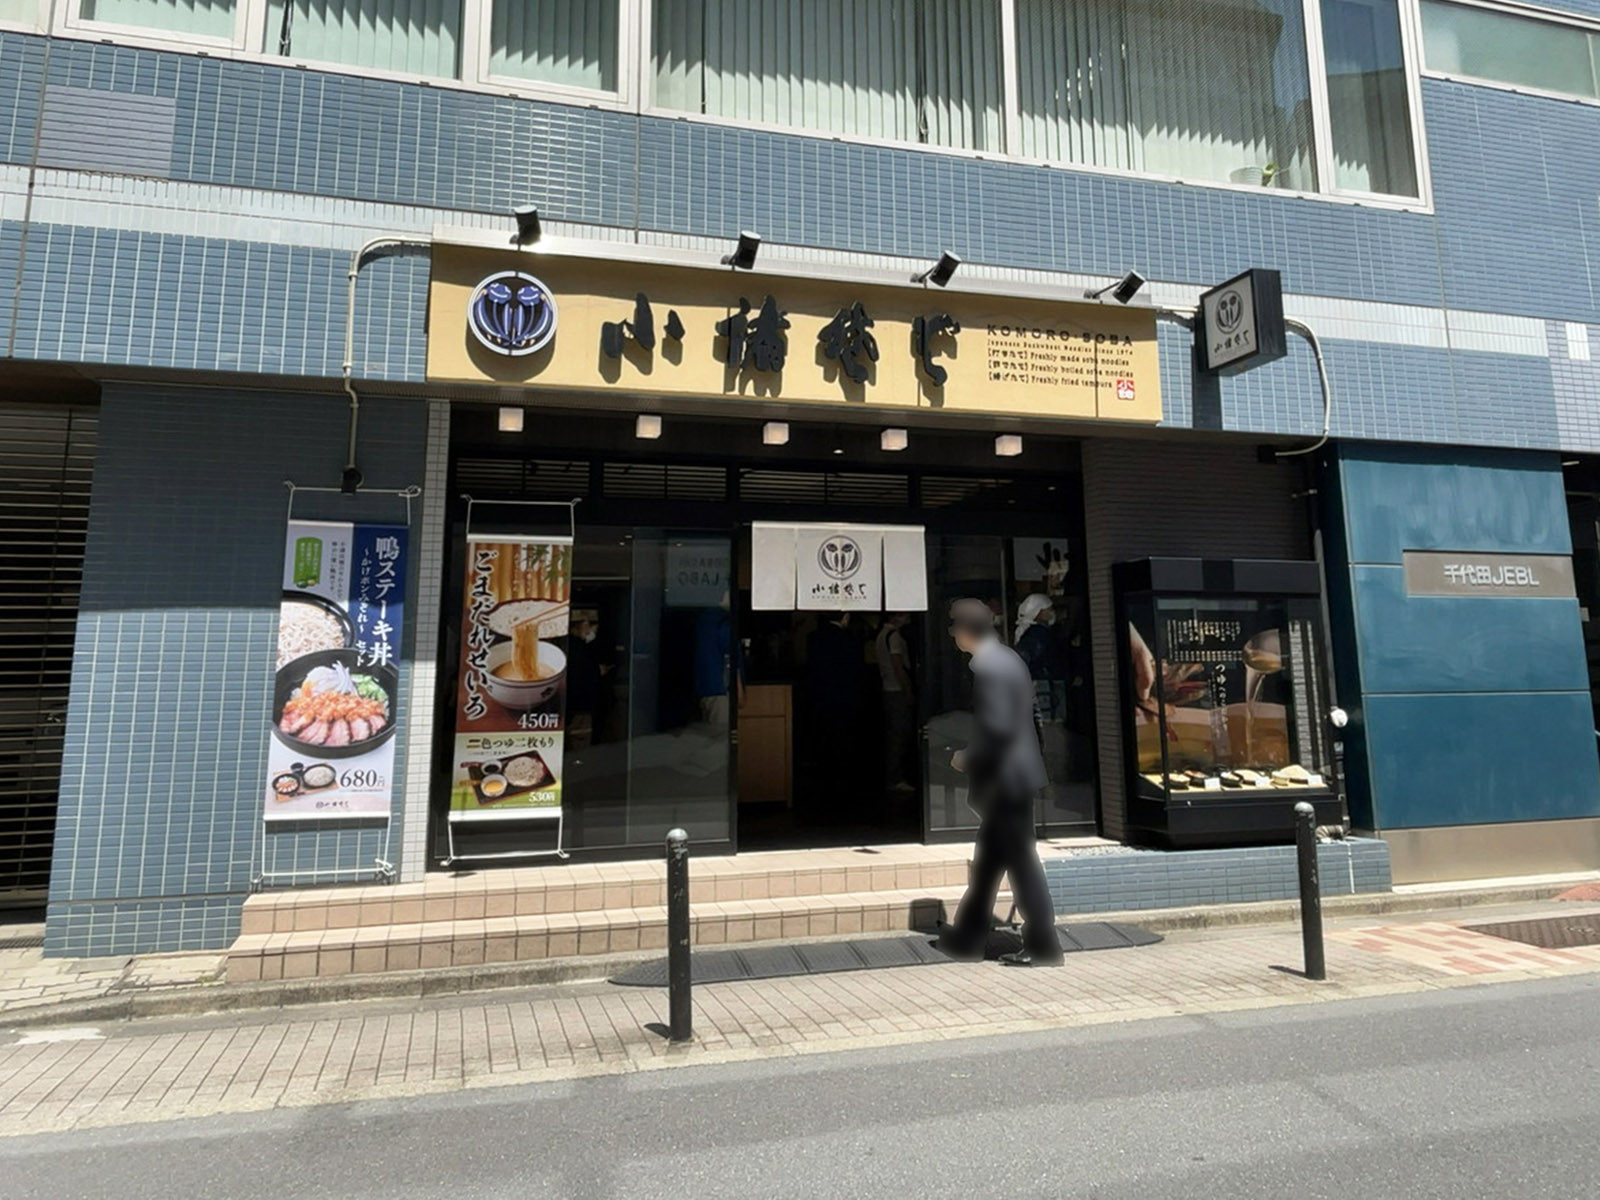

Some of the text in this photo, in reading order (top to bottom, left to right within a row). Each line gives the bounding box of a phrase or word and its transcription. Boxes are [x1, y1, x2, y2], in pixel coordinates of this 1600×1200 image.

[1082, 332, 1133, 347] SOBA
[1443, 563, 1540, 586] 千代田JEBL
[366, 536, 400, 667] 鴨ステーキ丼
[463, 549, 499, 721] ごまだれせいろ
[466, 736, 555, 750] 二色つゆ二枚もり
